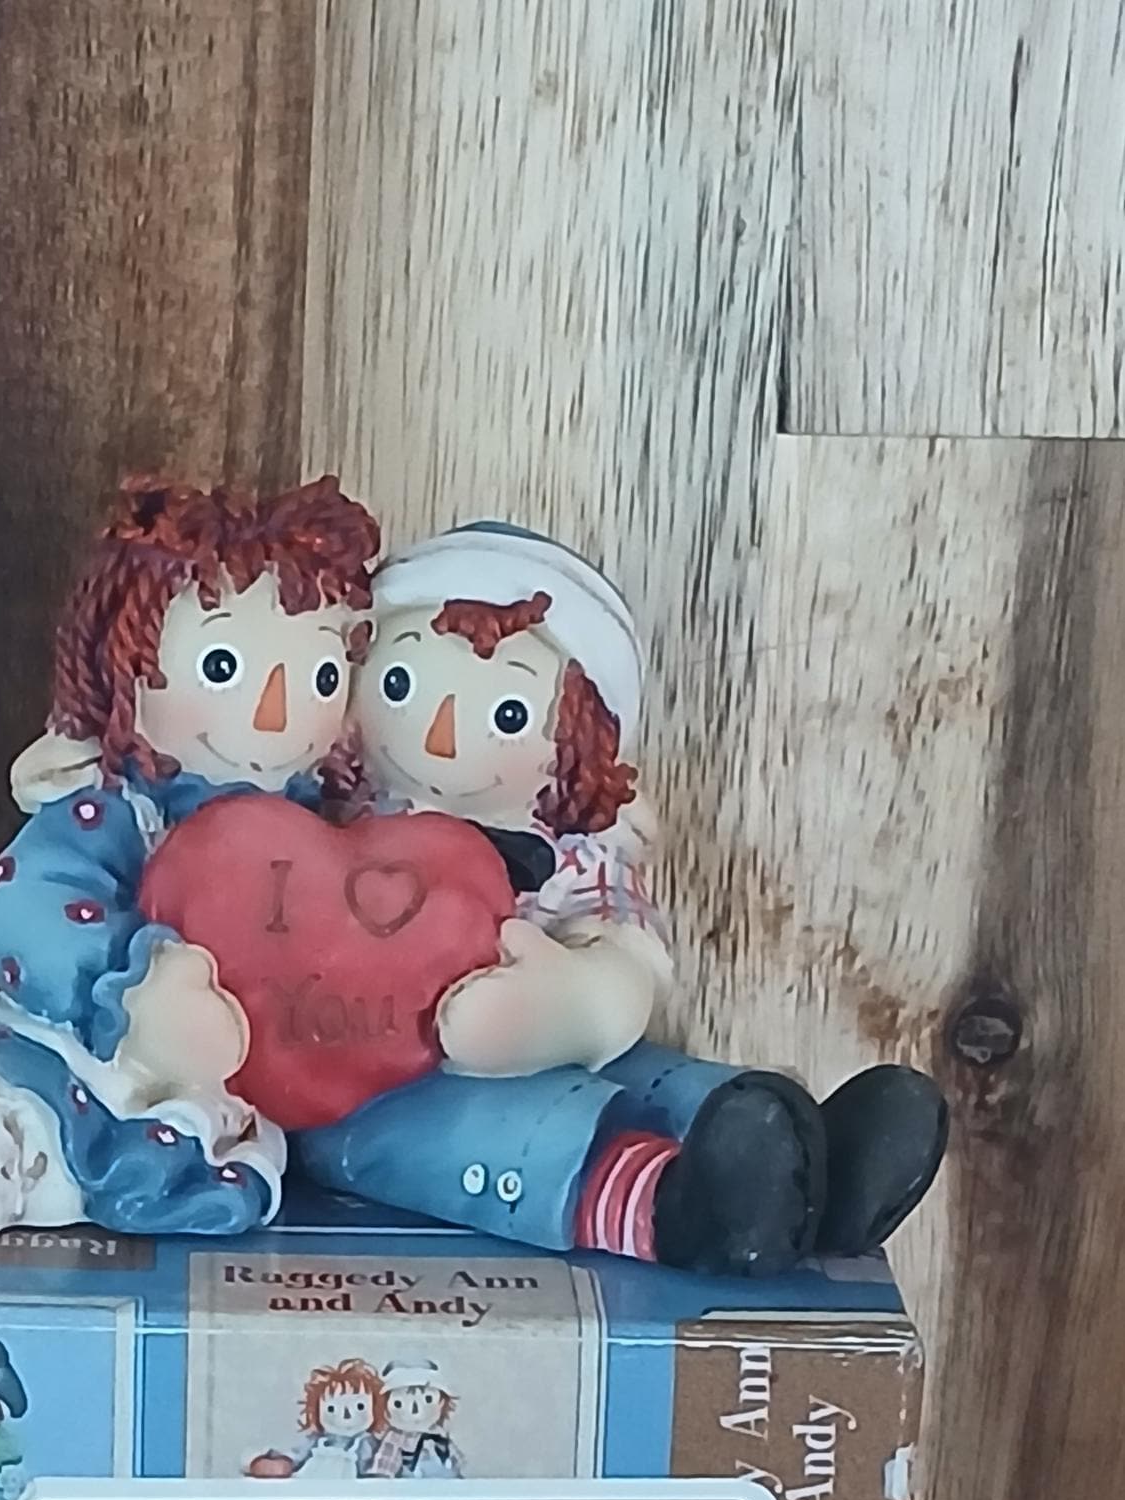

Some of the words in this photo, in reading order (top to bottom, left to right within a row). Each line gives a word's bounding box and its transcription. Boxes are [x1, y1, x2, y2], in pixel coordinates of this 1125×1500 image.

[224, 1265, 424, 1293] Raggedy
[449, 1270, 539, 1289] Ann
[268, 1293, 352, 1312] and
[375, 1292, 492, 1327] Andy
[719, 1345, 771, 1441] Ann
